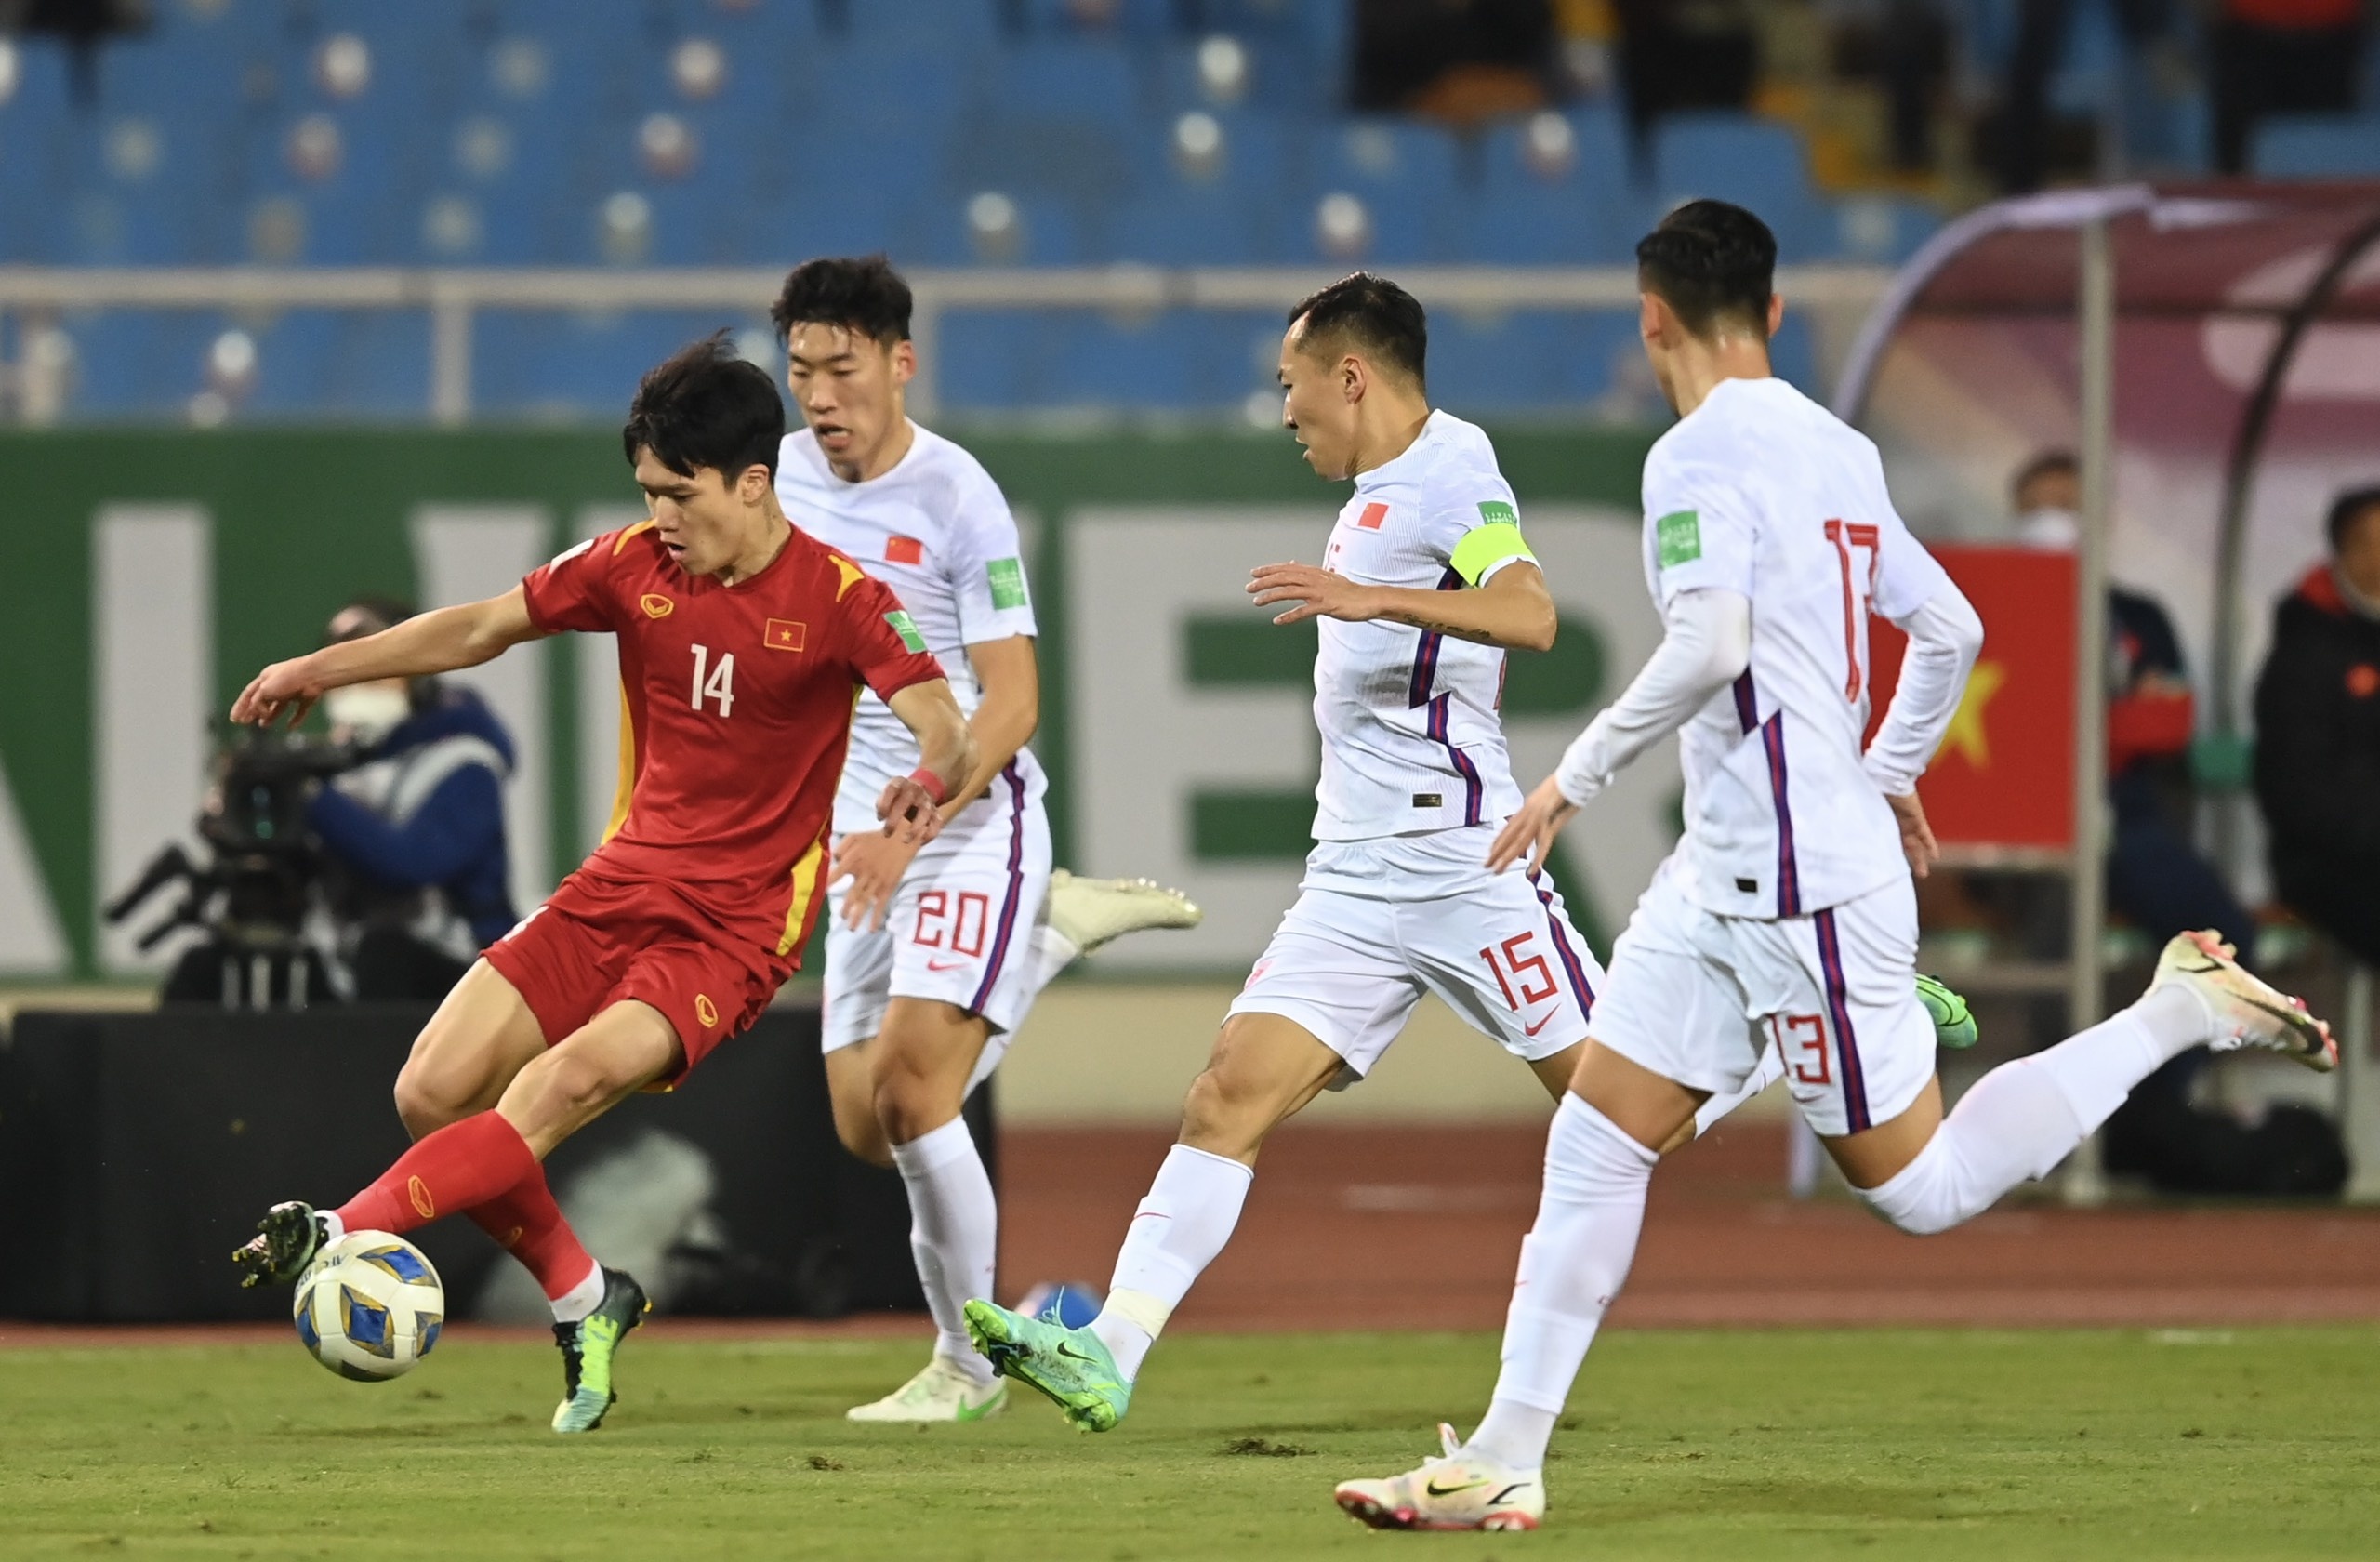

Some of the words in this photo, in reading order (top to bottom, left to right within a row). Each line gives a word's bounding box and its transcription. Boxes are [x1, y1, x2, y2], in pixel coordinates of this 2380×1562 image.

[691, 643, 734, 718] 14
[913, 890, 988, 958] 20
[1479, 931, 1558, 1012] 15
[1769, 1014, 1831, 1084] 13
